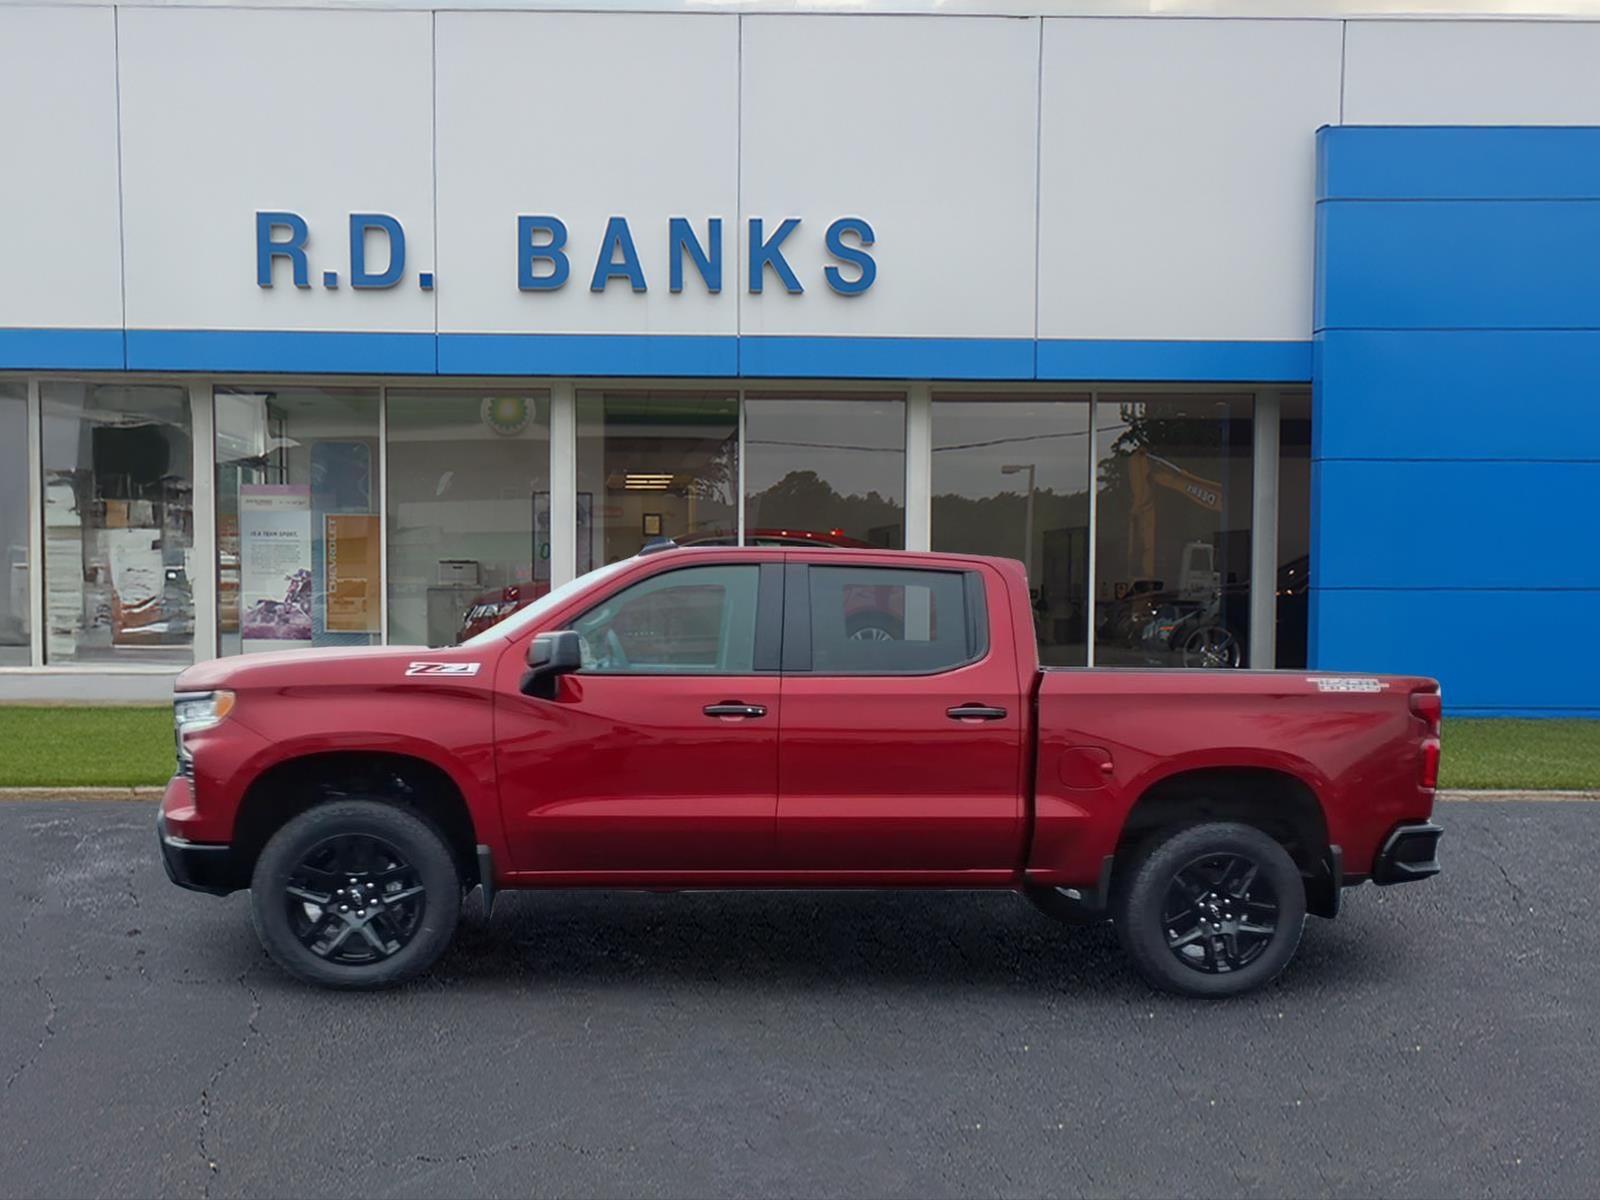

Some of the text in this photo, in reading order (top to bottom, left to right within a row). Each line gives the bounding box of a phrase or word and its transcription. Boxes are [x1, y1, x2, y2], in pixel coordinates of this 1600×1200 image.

[256, 211, 877, 296] R.D. BANKS
[327, 518, 337, 593] CHEVROLET
